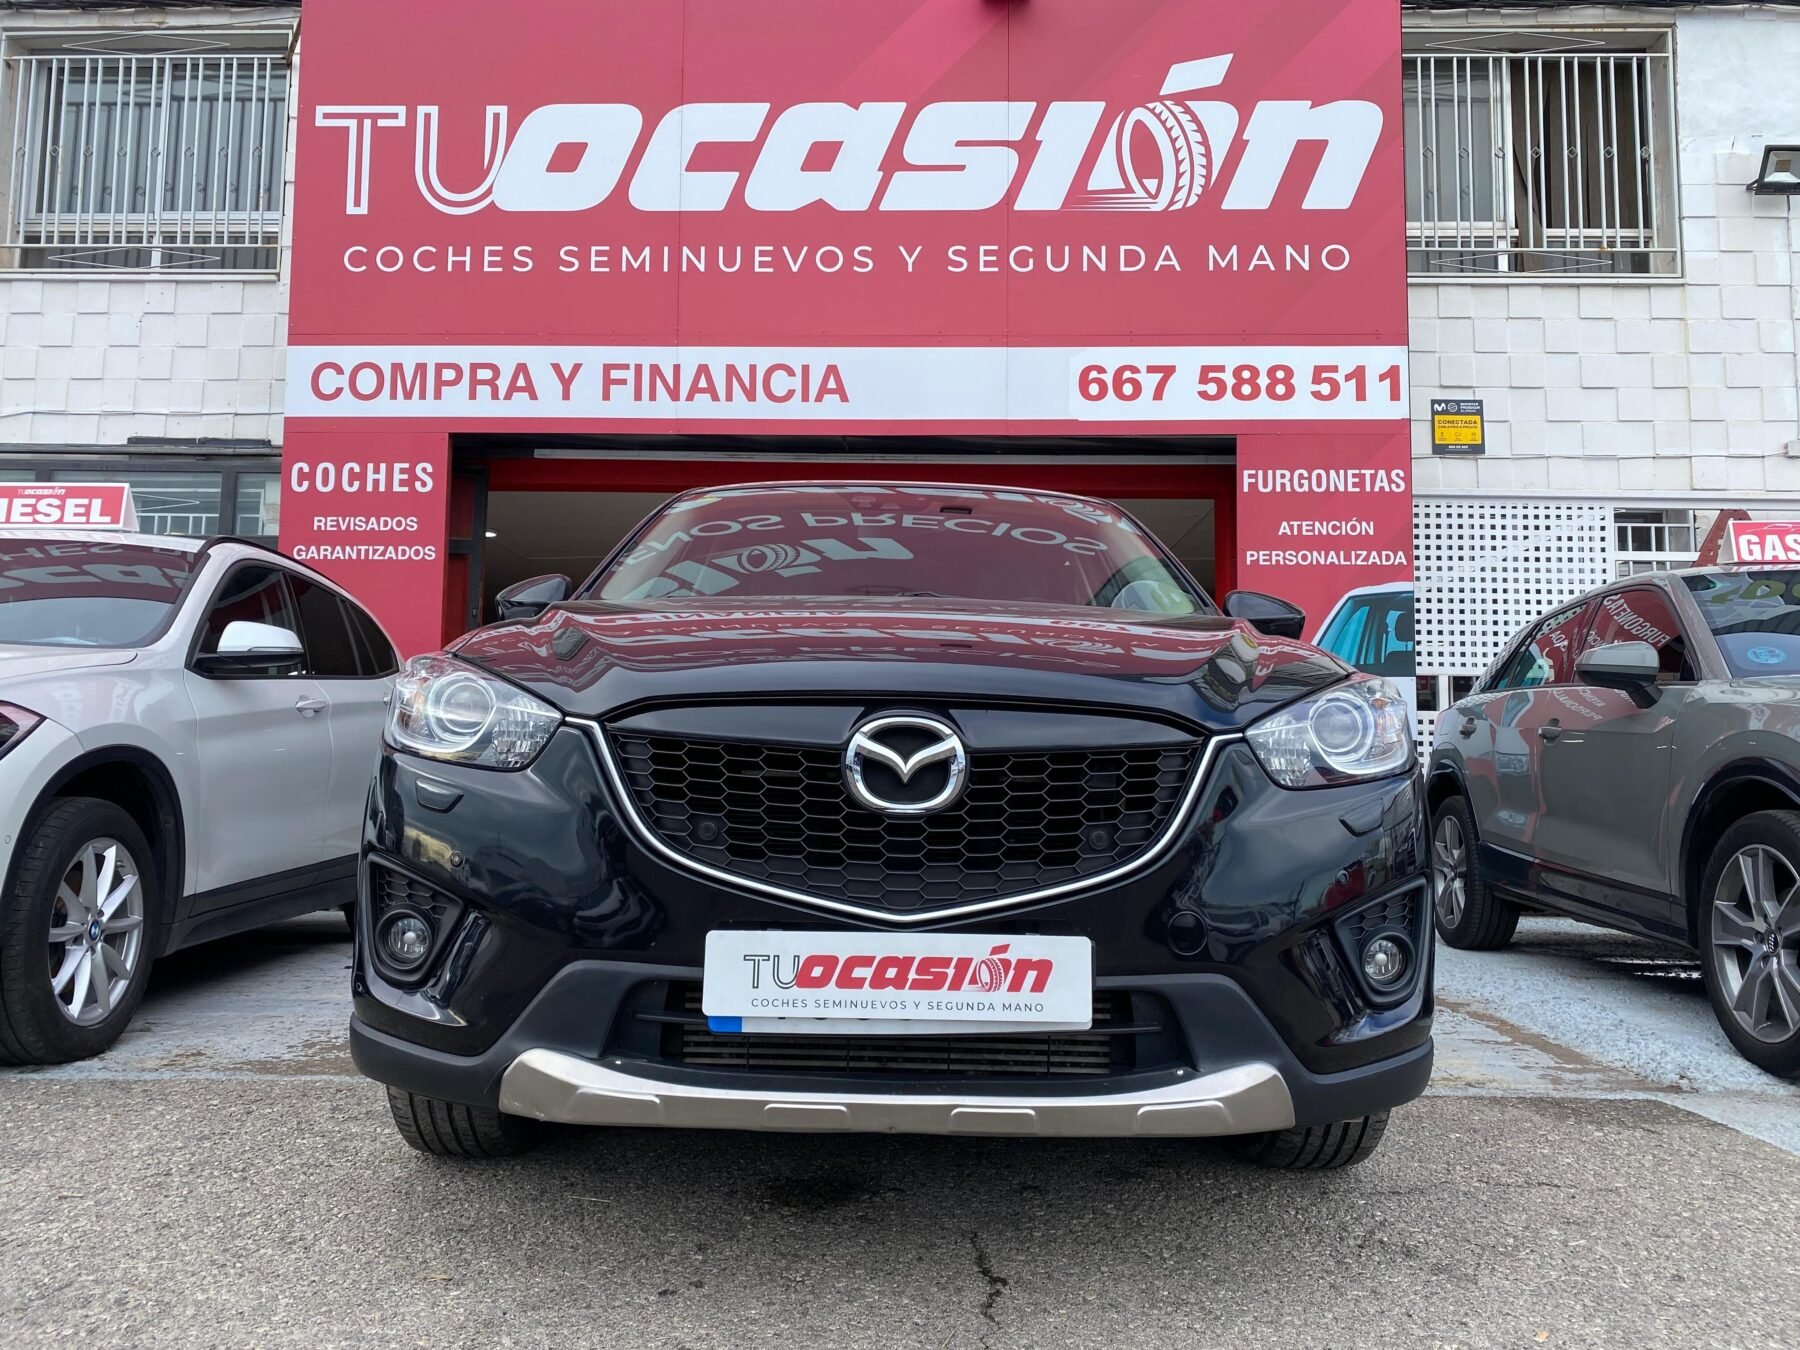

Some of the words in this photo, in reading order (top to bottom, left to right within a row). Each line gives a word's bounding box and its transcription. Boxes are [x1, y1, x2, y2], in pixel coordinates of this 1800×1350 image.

[344, 244, 533, 273] COCHES
[559, 244, 874, 273] SEMINUEVOS
[898, 245, 922, 272] Y
[947, 244, 1182, 273] SEGUNDA
[1208, 244, 1350, 272] MANO
[311, 361, 537, 402] COMPRA
[552, 362, 582, 402] Y
[602, 362, 849, 403] FINANCIA
[1077, 364, 1177, 402] 667
[1197, 364, 1296, 402] 588
[1310, 364, 1401, 402] 511
[291, 462, 434, 493] COCHES
[1243, 469, 1406, 493] FURGONETAS
[0, 497, 112, 523] IESEL
[313, 516, 418, 531] REVISADOS
[1278, 517, 1374, 536] ATENCIÓN
[292, 545, 436, 561] GARANTIZADOS
[1246, 550, 1407, 566] PERSONALIZADA
[1738, 533, 1800, 562] GAS
[750, 997, 808, 1009] COCHES
[813, 998, 908, 1011] SEMINUEVOS
[912, 1001, 921, 1011] Y
[927, 1000, 997, 1013] SEGUNDA
[1002, 1001, 1045, 1013] MANO
